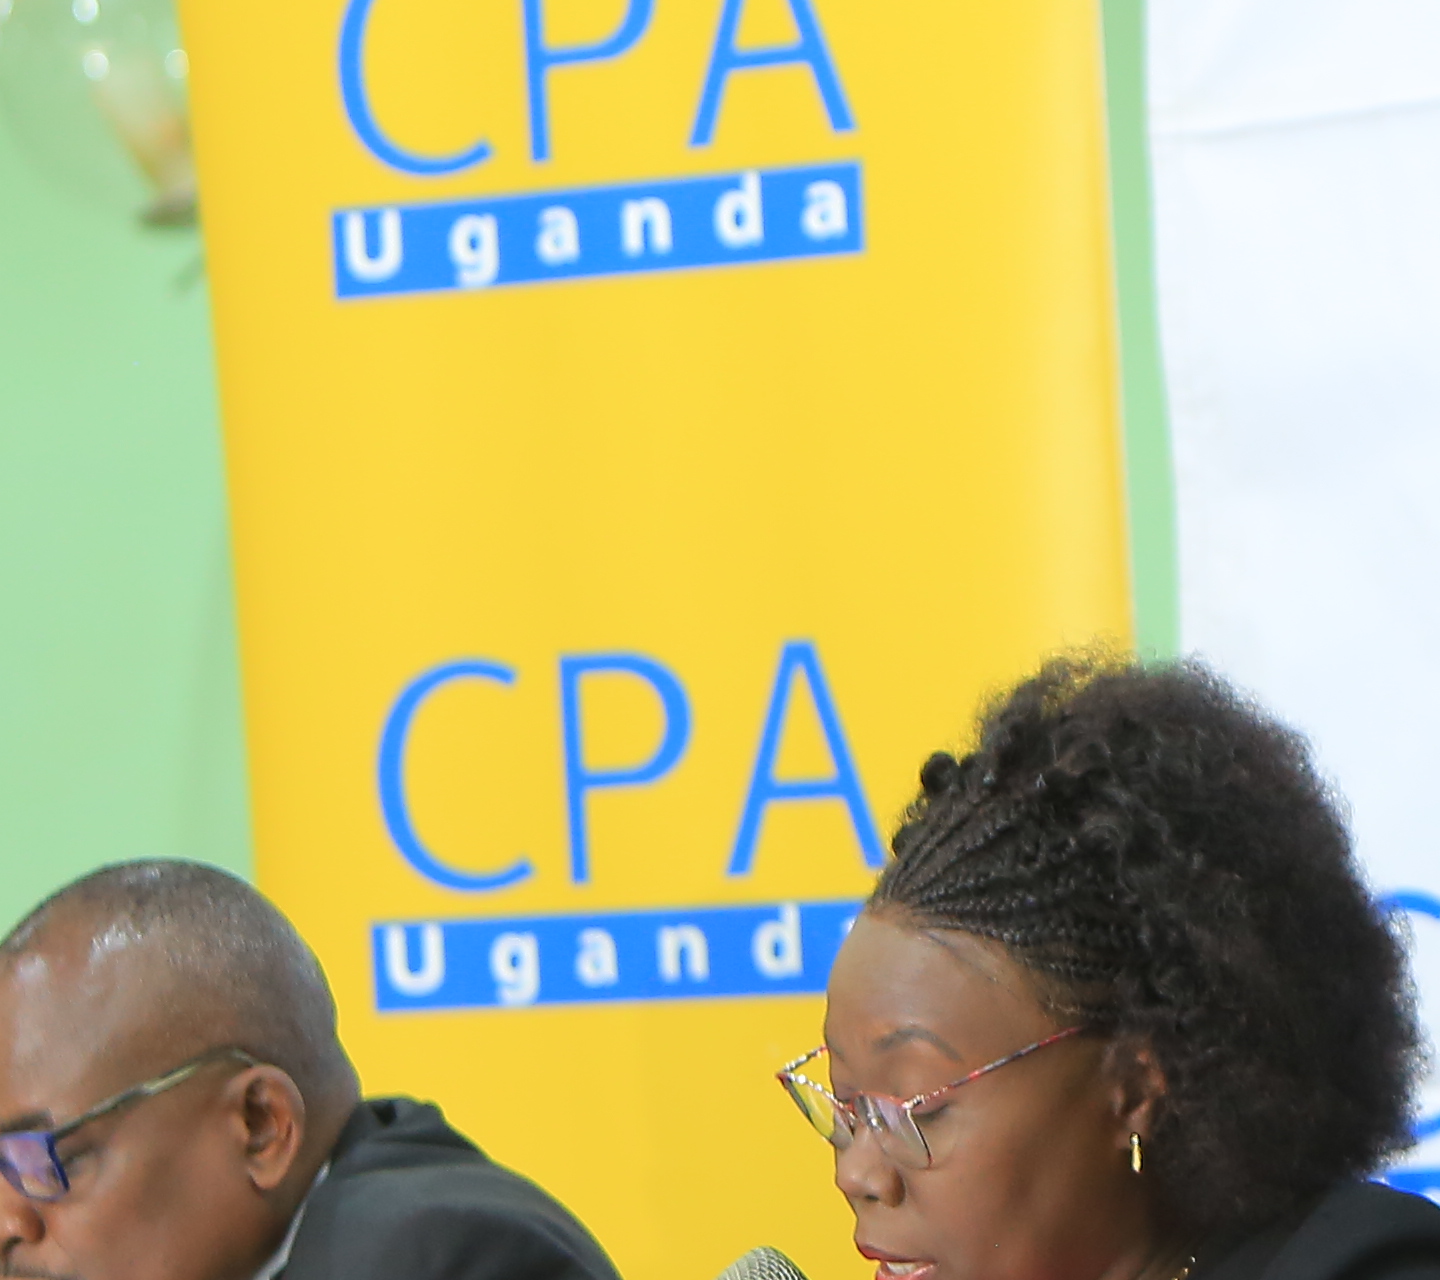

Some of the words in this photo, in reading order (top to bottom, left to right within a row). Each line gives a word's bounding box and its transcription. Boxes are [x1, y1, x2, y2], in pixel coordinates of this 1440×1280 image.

[344, 173, 849, 285] Uganda
[378, 642, 885, 892] CPA
[385, 904, 855, 1005] Ugand
